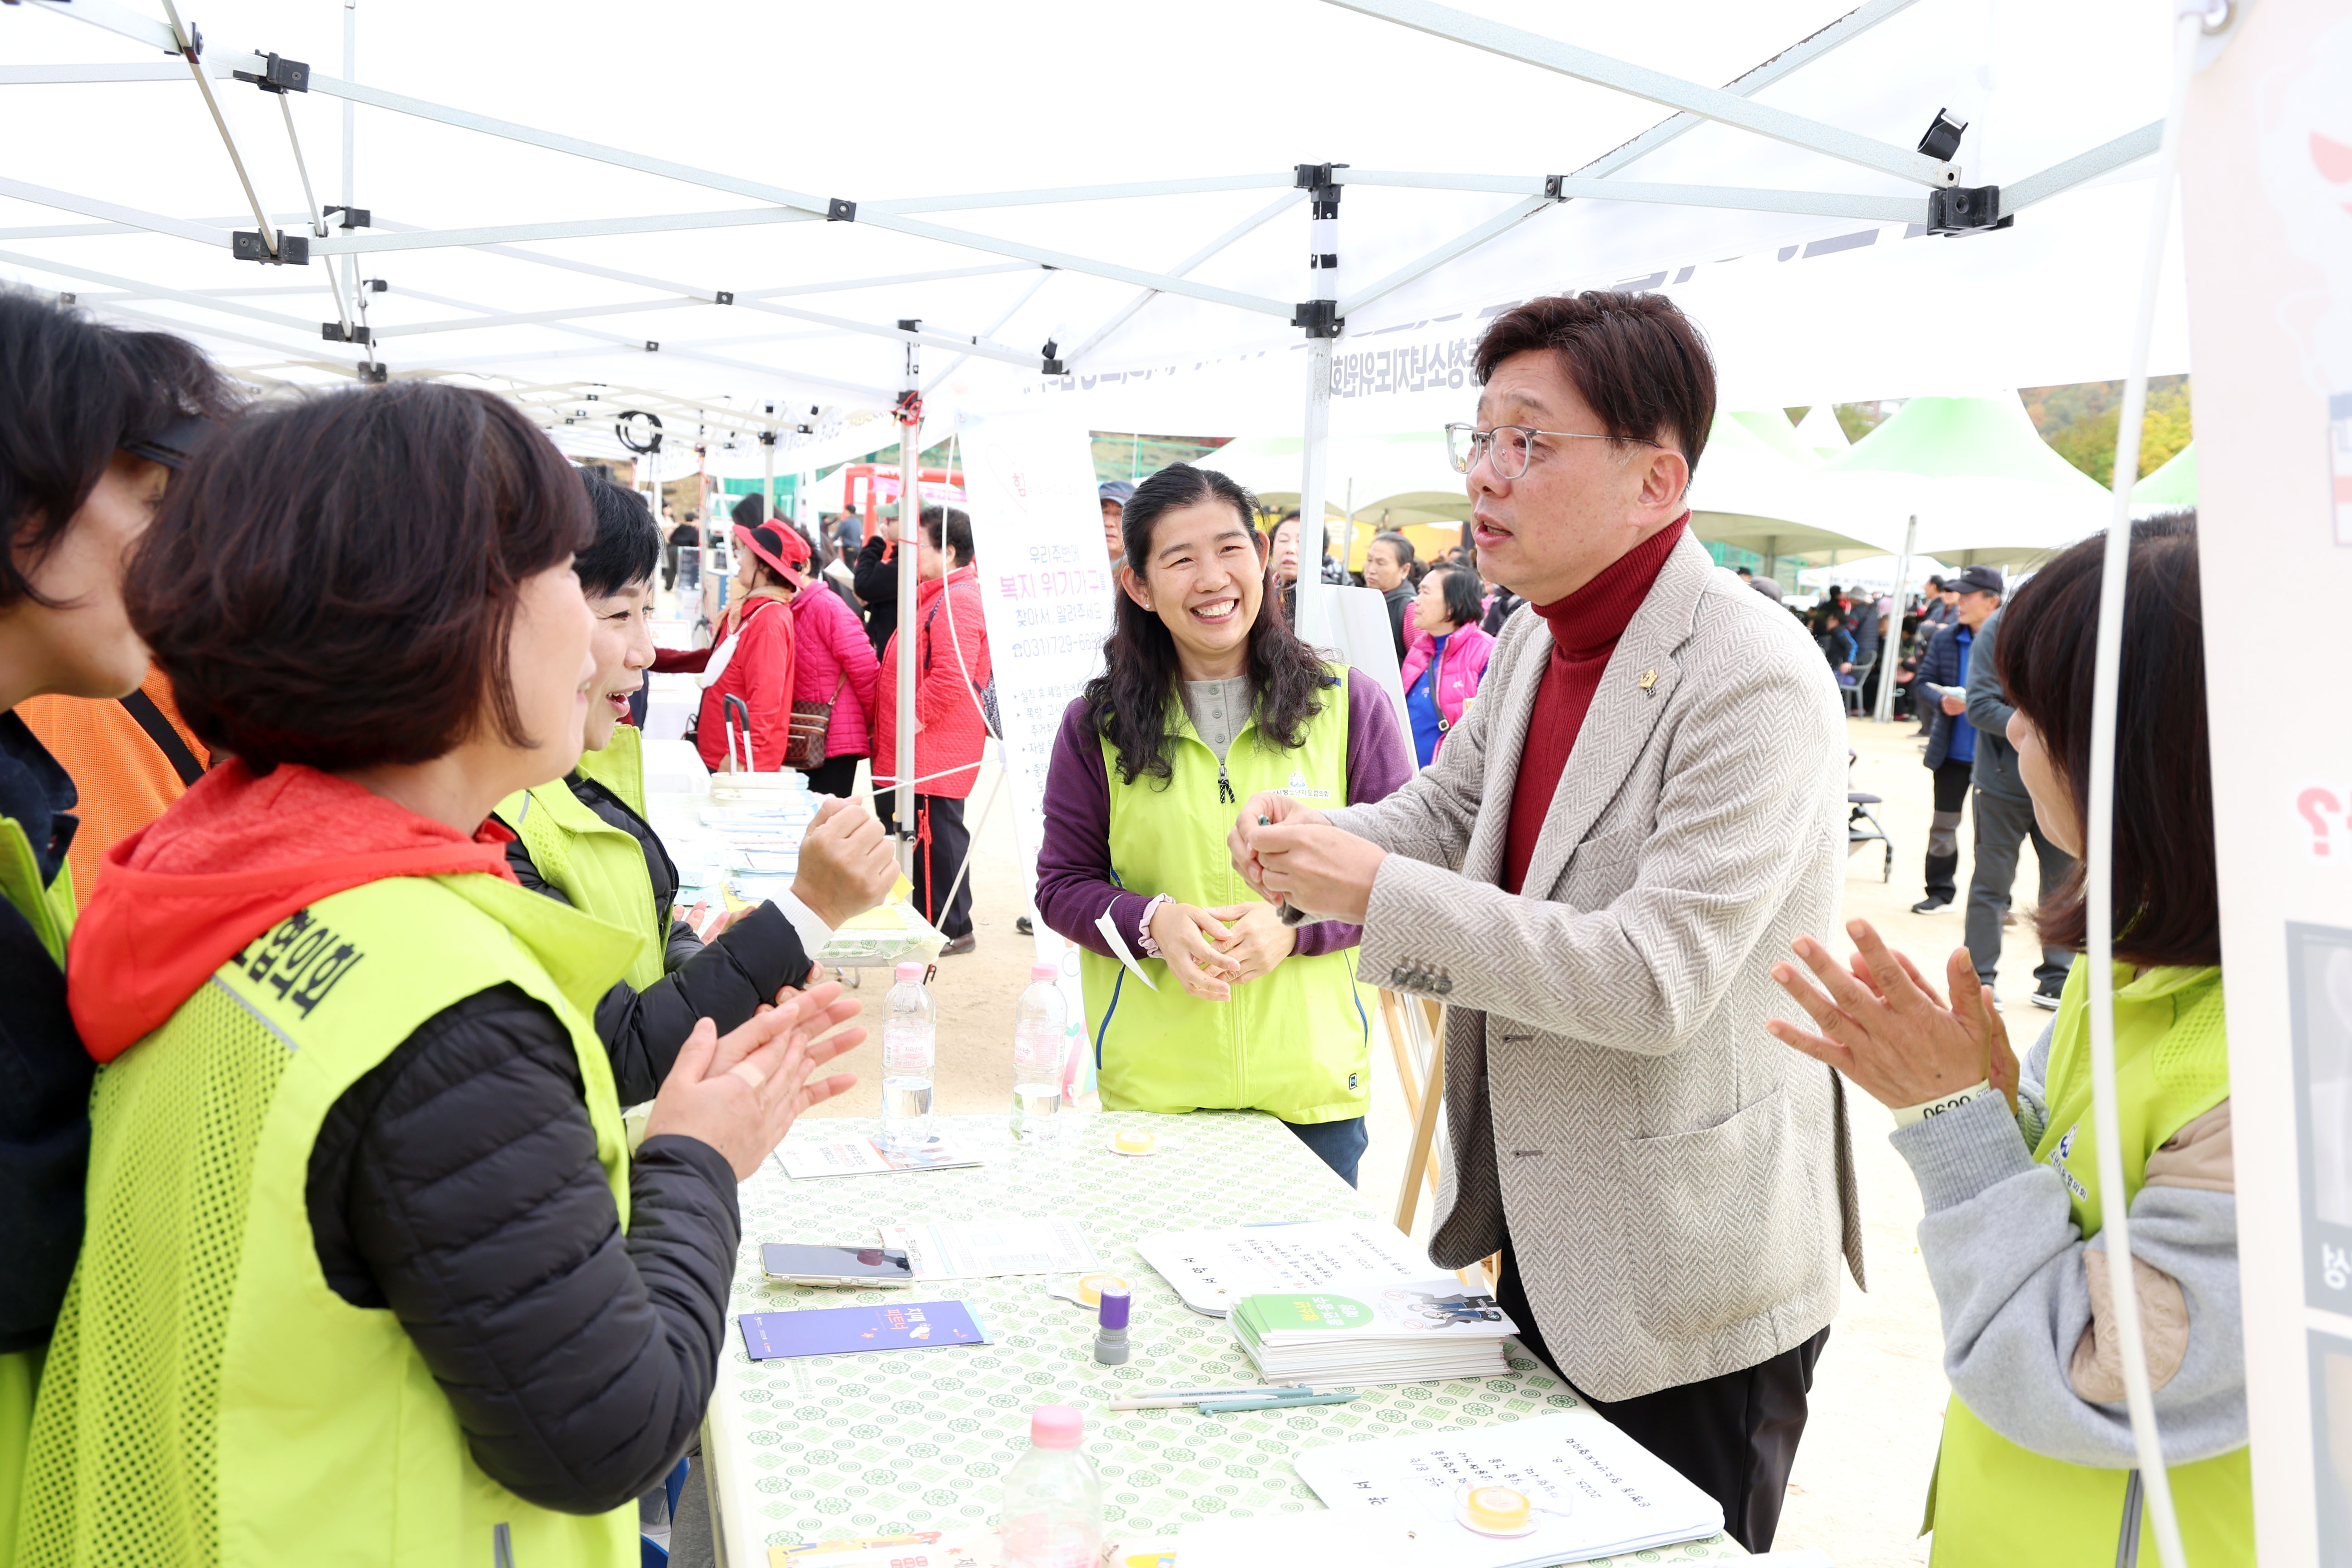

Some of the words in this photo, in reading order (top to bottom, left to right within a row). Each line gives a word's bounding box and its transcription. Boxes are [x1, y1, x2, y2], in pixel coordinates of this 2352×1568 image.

[1012, 473, 1026, 497] 힘
[1029, 544, 1080, 563] 우리주변에
[1000, 573, 1035, 601] 복지
[1041, 570, 1106, 598] 위기가구를
[1015, 607, 1055, 627] 찾아서,
[1029, 740, 1044, 754] 자살
[230, 908, 365, 1020] 협의회
[904, 1045, 924, 1054] 지리산수
[1355, 1257, 1374, 1269] 2025.
[886, 1308, 909, 1330] 파트너
[904, 1307, 926, 1322] 치매
[1292, 1301, 1319, 1321] 청소년
[1337, 1304, 1360, 1317] 예방
[1431, 1451, 1459, 1474] 위험성을
[1488, 1459, 1507, 1470] 것을
[1563, 1466, 1576, 1475] 11.
[1564, 1438, 1622, 1484] 청소년지도협의회
[1353, 1481, 1372, 1489] 서
[1576, 1479, 1602, 1498] 2025.
[1367, 1497, 1389, 1505] 약
[1621, 1488, 1651, 1507] 은행1동
